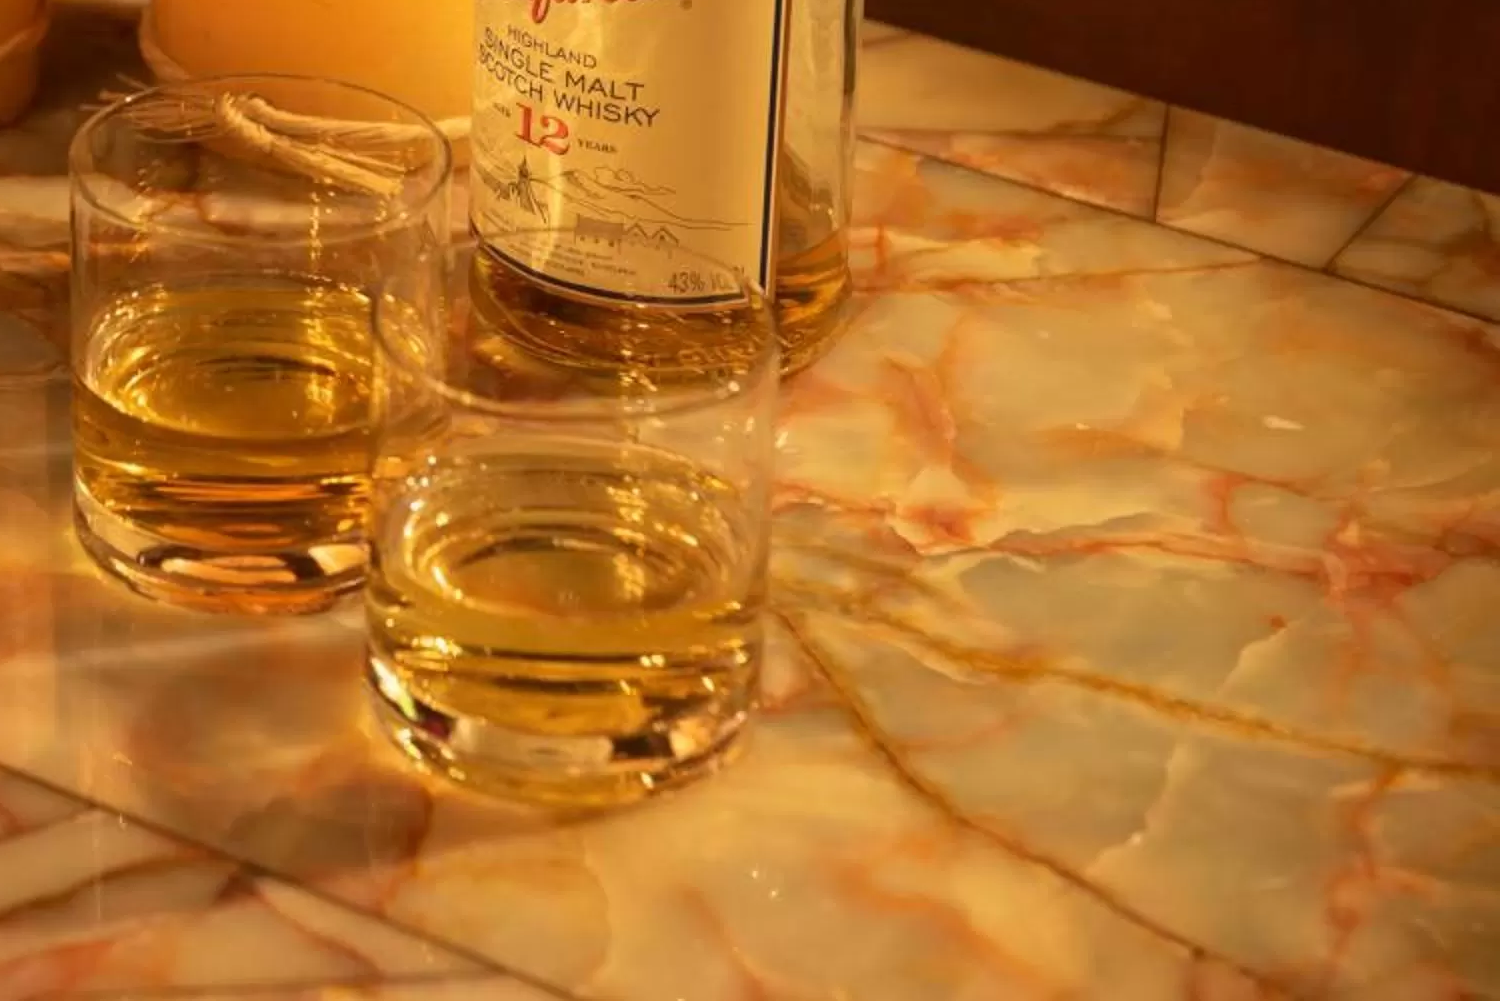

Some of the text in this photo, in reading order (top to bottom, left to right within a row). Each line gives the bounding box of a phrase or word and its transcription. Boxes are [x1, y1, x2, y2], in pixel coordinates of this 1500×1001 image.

[484, 26, 645, 102] SINGLE MALT
[507, 24, 598, 70] HIGHLAND
[479, 43, 661, 128] SCOTCH WHISKY
[514, 102, 570, 155] 12
